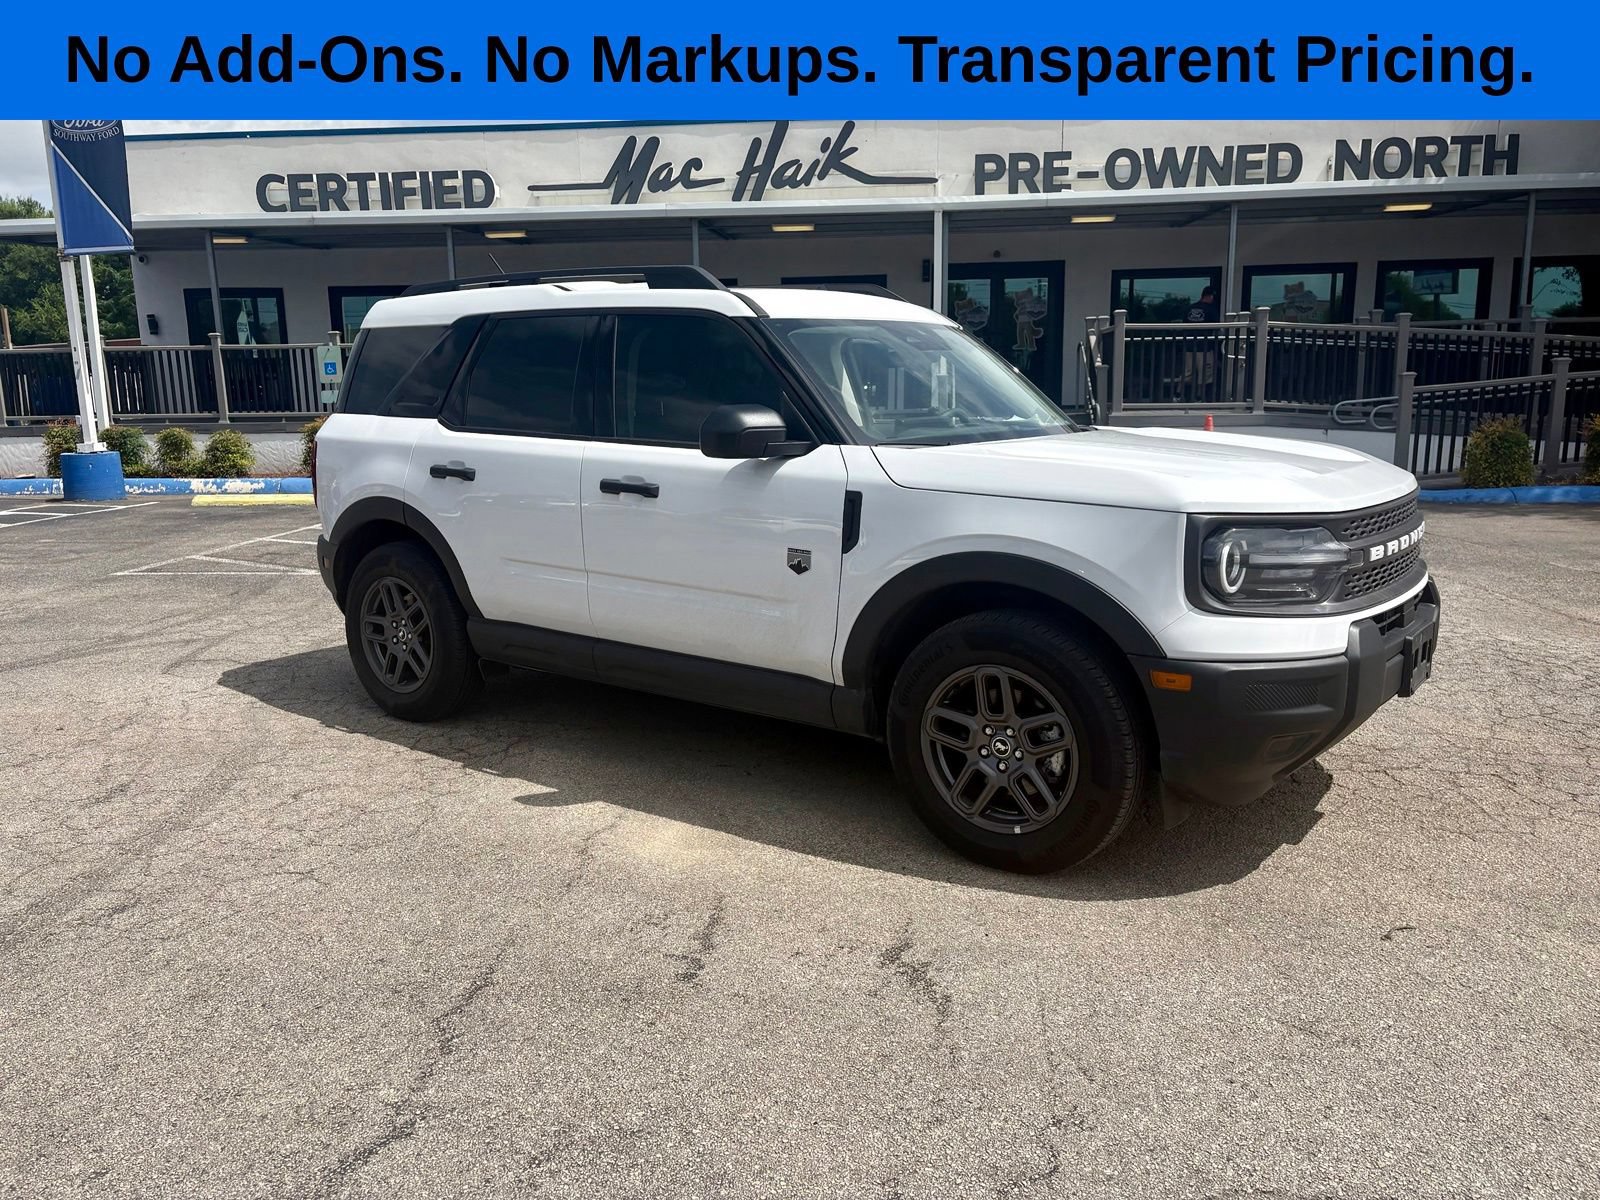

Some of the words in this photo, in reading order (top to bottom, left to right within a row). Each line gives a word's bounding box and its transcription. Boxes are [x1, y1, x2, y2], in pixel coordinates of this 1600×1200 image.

[53, 129, 97, 142] SOUTHWAY
[98, 126, 120, 141] FORD
[527, 135, 725, 204] Mac
[731, 120, 938, 202] Haik
[974, 142, 1304, 195] PRE-OWNED
[1333, 133, 1520, 181] NORTH
[256, 170, 496, 213] CERTIFIED
